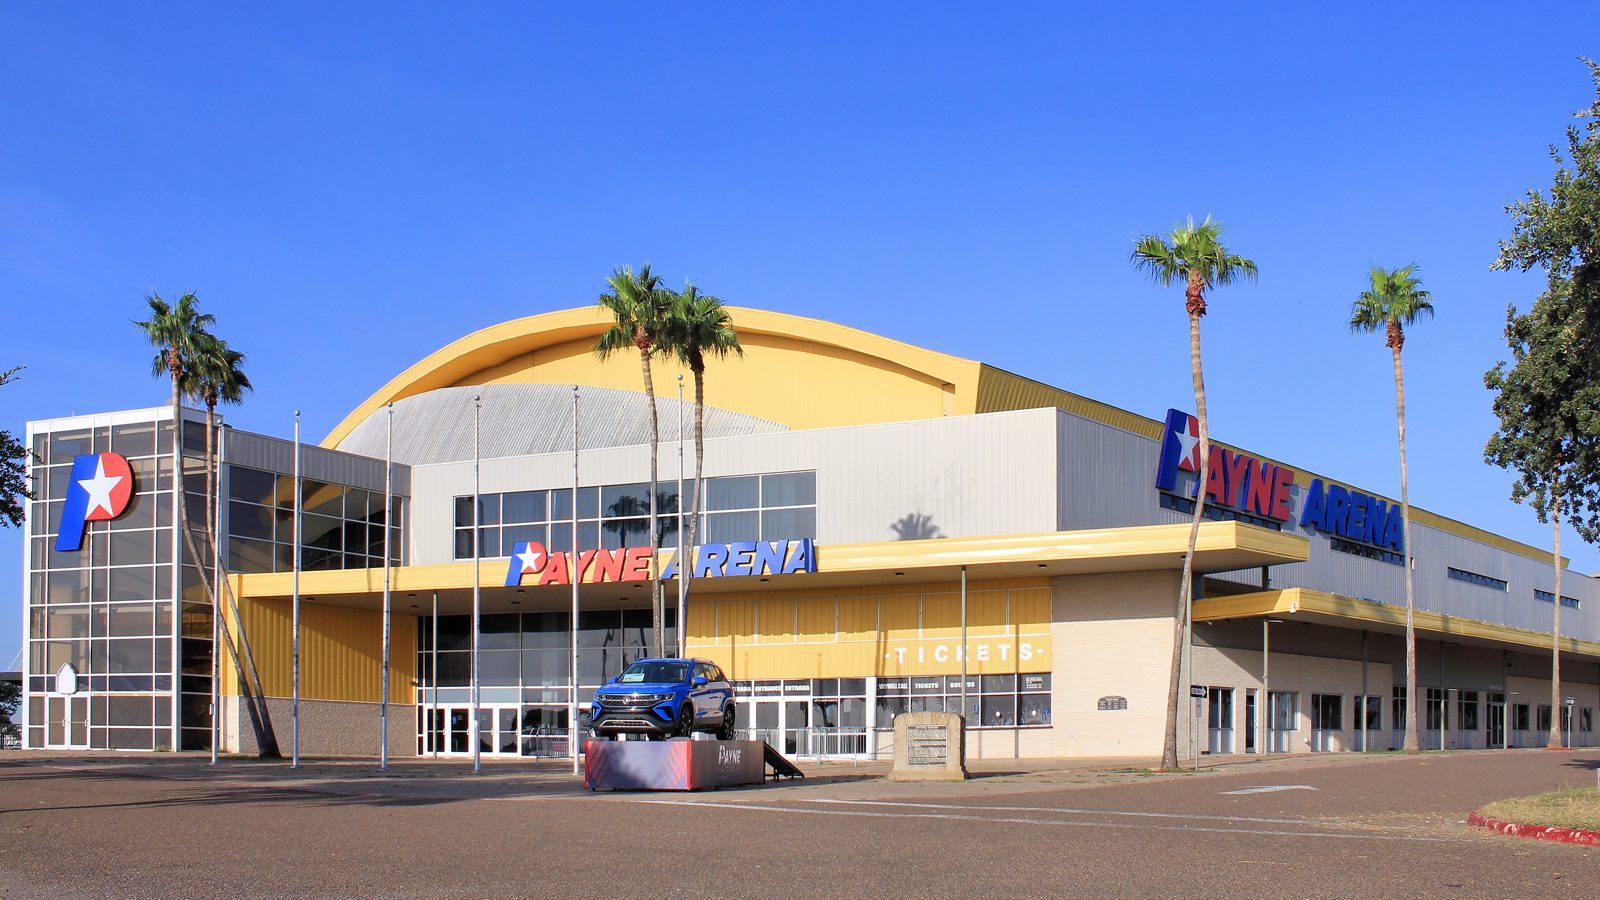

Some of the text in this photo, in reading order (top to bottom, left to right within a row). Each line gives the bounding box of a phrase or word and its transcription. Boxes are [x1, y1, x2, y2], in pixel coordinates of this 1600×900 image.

[55, 452, 135, 551] P
[1156, 408, 1405, 551] PAYNE ARENA
[505, 538, 817, 587] PAYNE ARENA
[895, 643, 1033, 664] TICKETS
[718, 745, 742, 765] PAYNE
